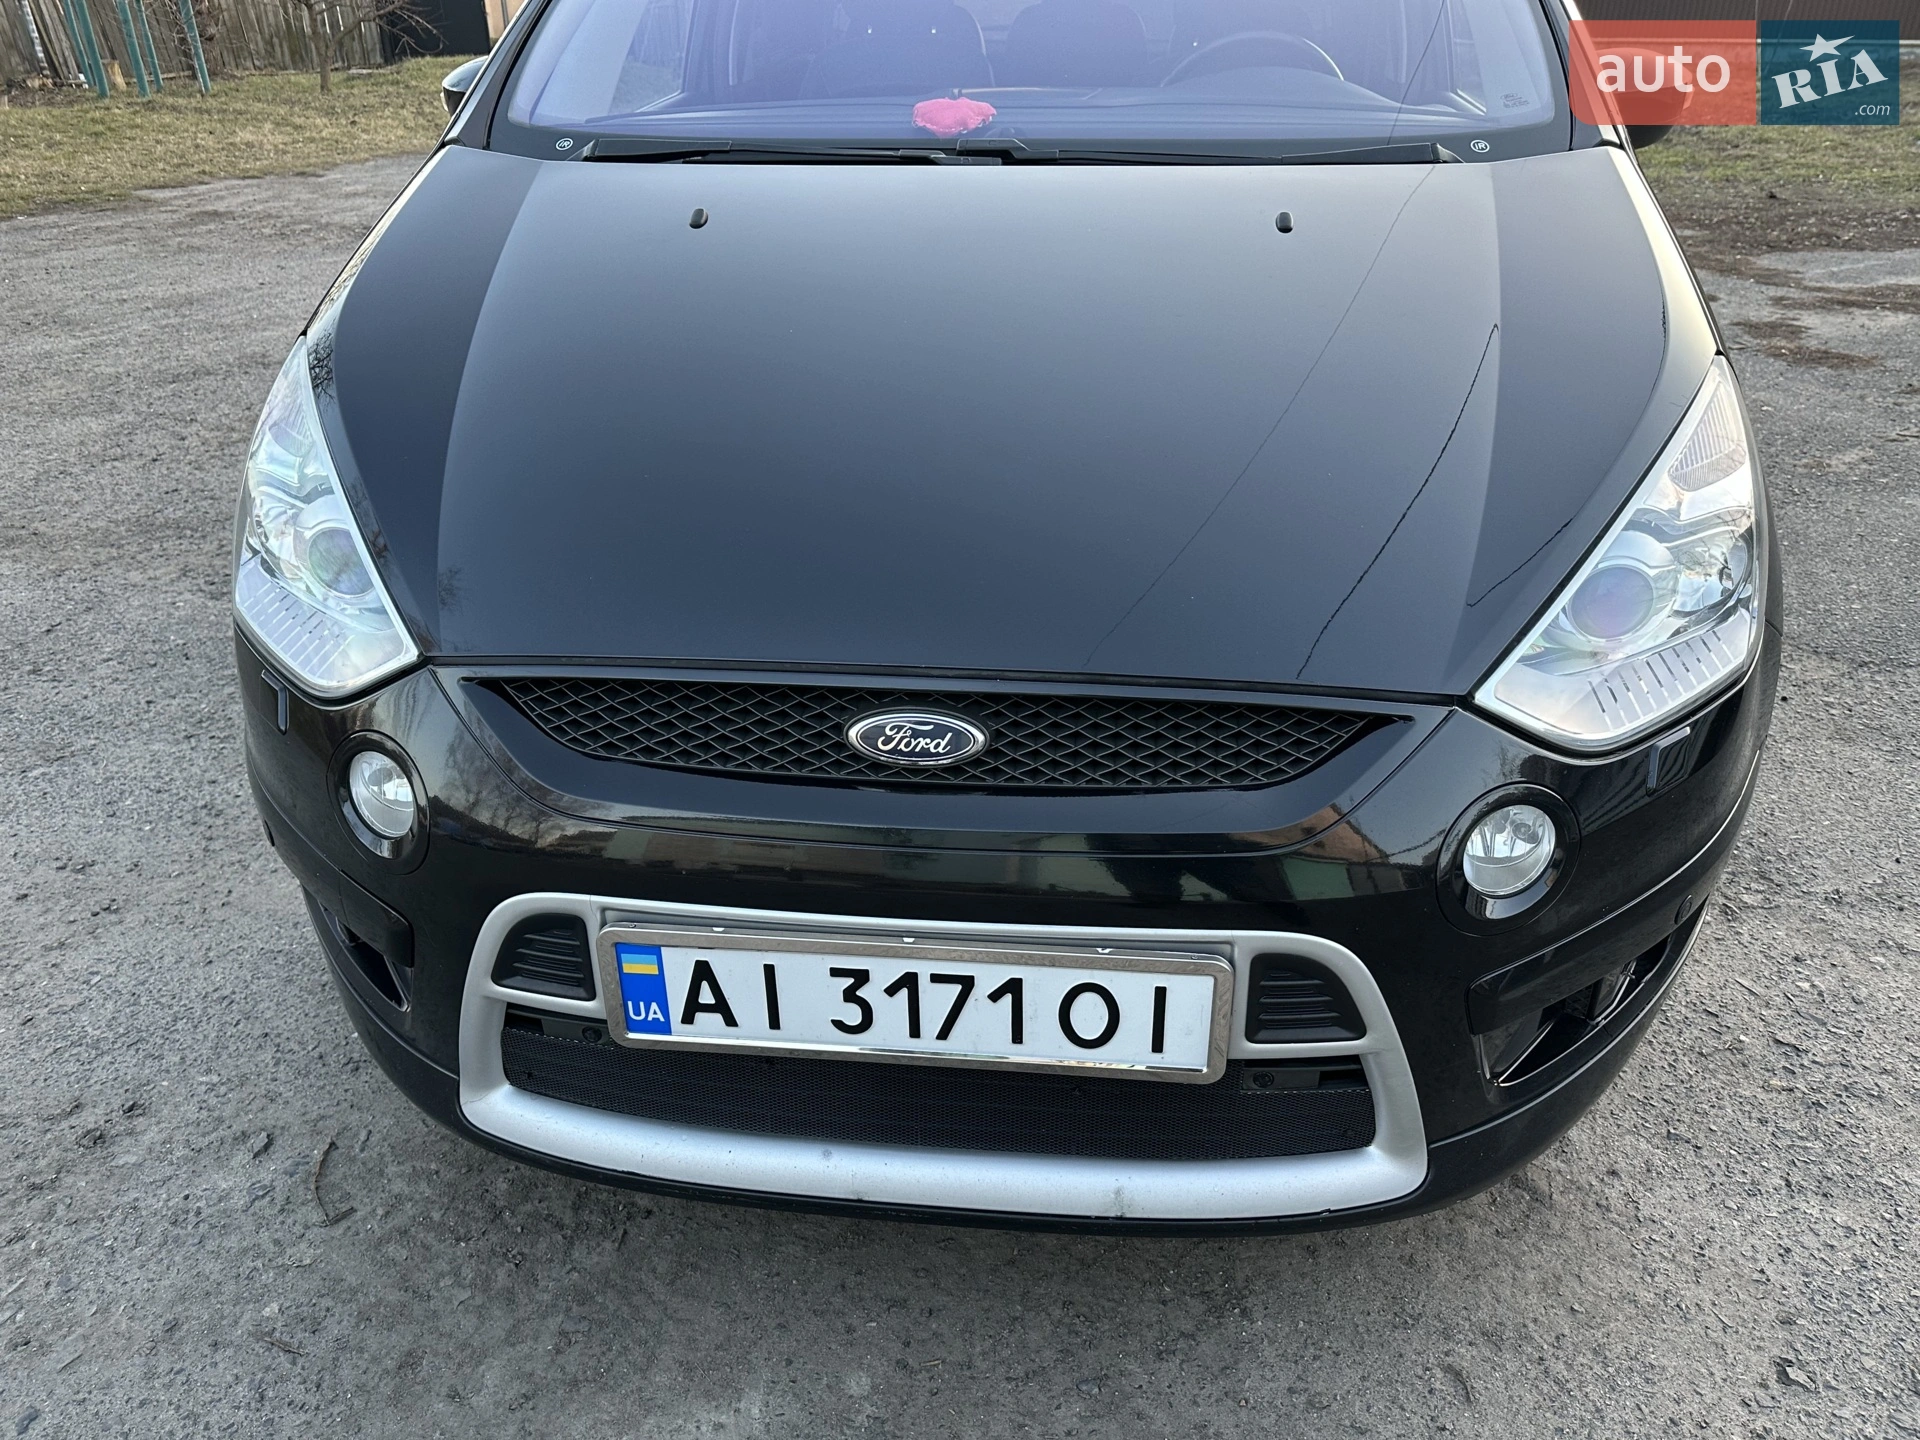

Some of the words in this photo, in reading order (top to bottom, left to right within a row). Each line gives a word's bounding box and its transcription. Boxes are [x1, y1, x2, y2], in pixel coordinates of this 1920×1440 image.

[877, 722, 953, 754] Ford
[627, 1000, 665, 1022] UA
[829, 966, 1024, 1045] 3171
